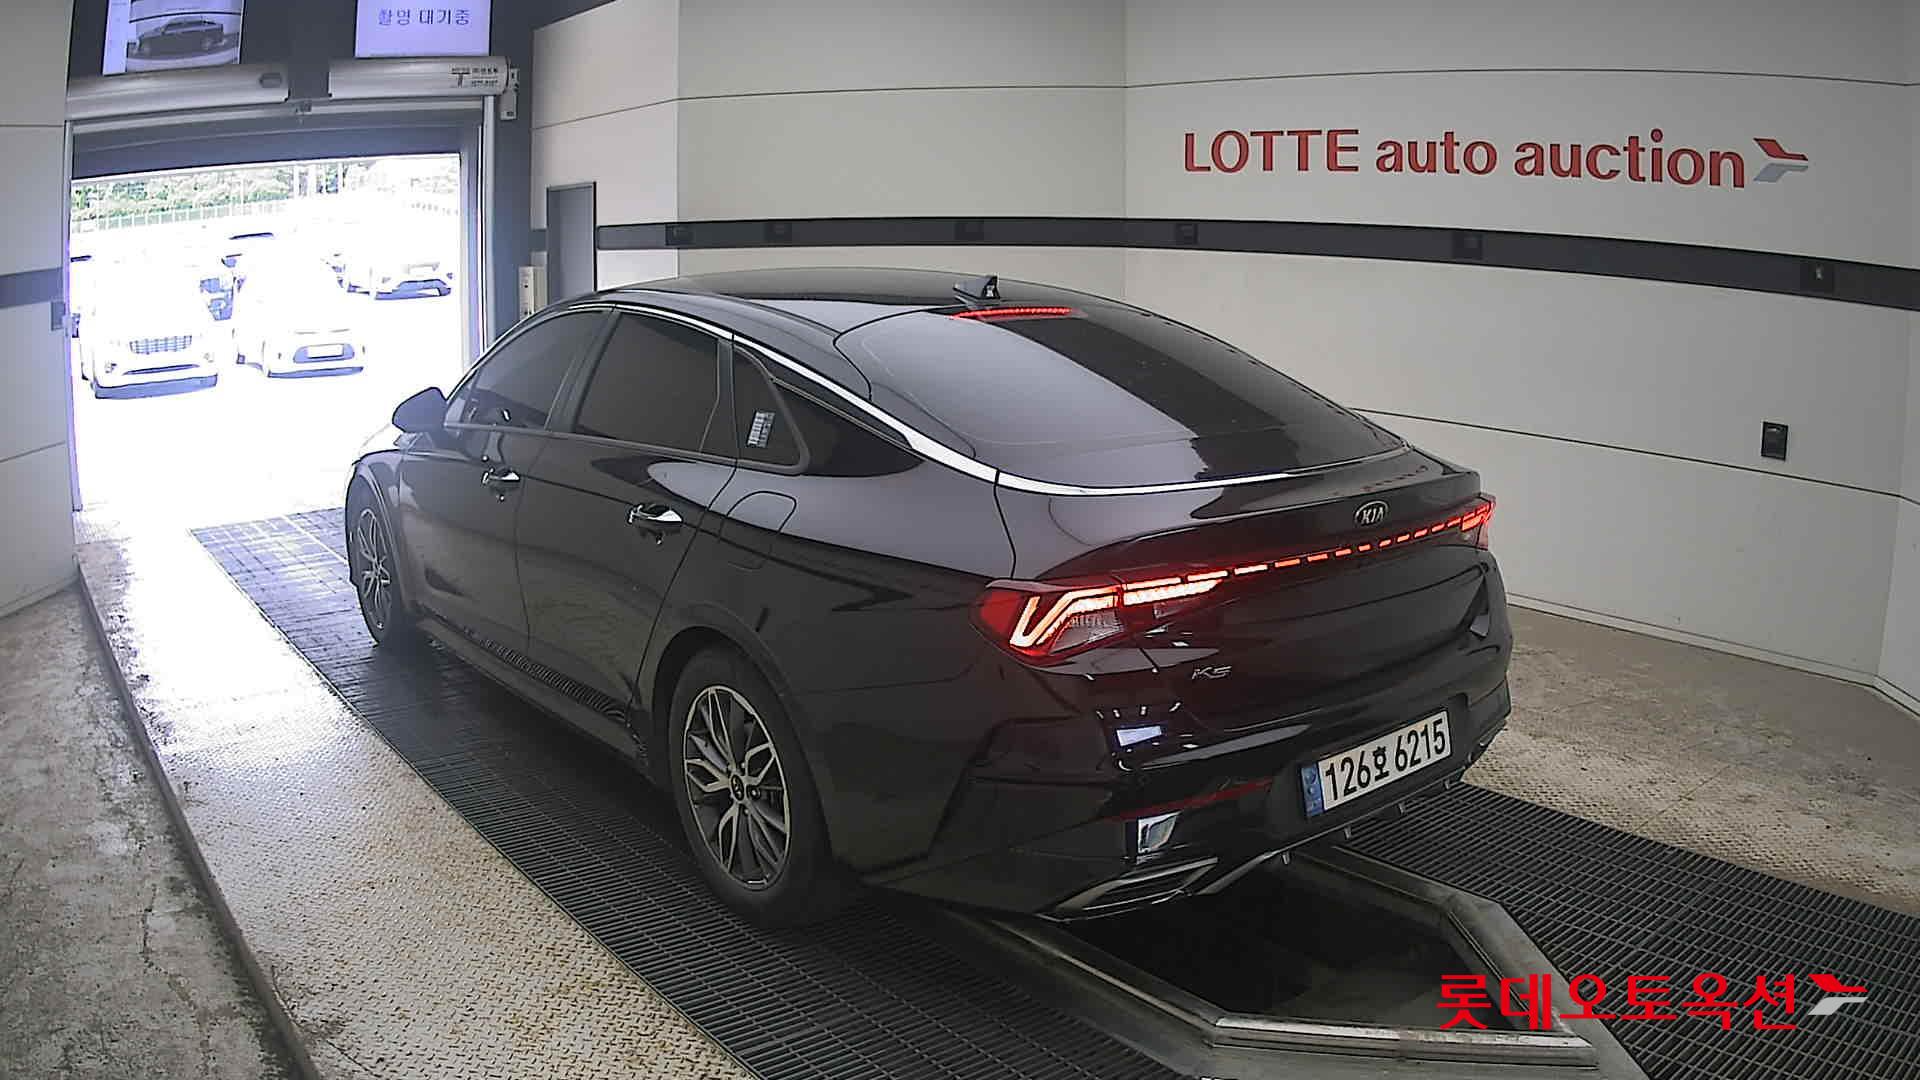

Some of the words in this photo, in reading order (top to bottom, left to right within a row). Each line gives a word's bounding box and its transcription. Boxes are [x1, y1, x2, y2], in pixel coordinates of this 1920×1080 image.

[419, 9, 470, 25] 대기중
[1184, 128, 1360, 174] LOTTE
[1375, 131, 1498, 176] auto
[1514, 129, 1745, 189] auction
[1361, 506, 1384, 525] KIA
[1191, 665, 1232, 680] K5
[1325, 746, 1390, 801] 126호
[1394, 718, 1446, 772] 6215
